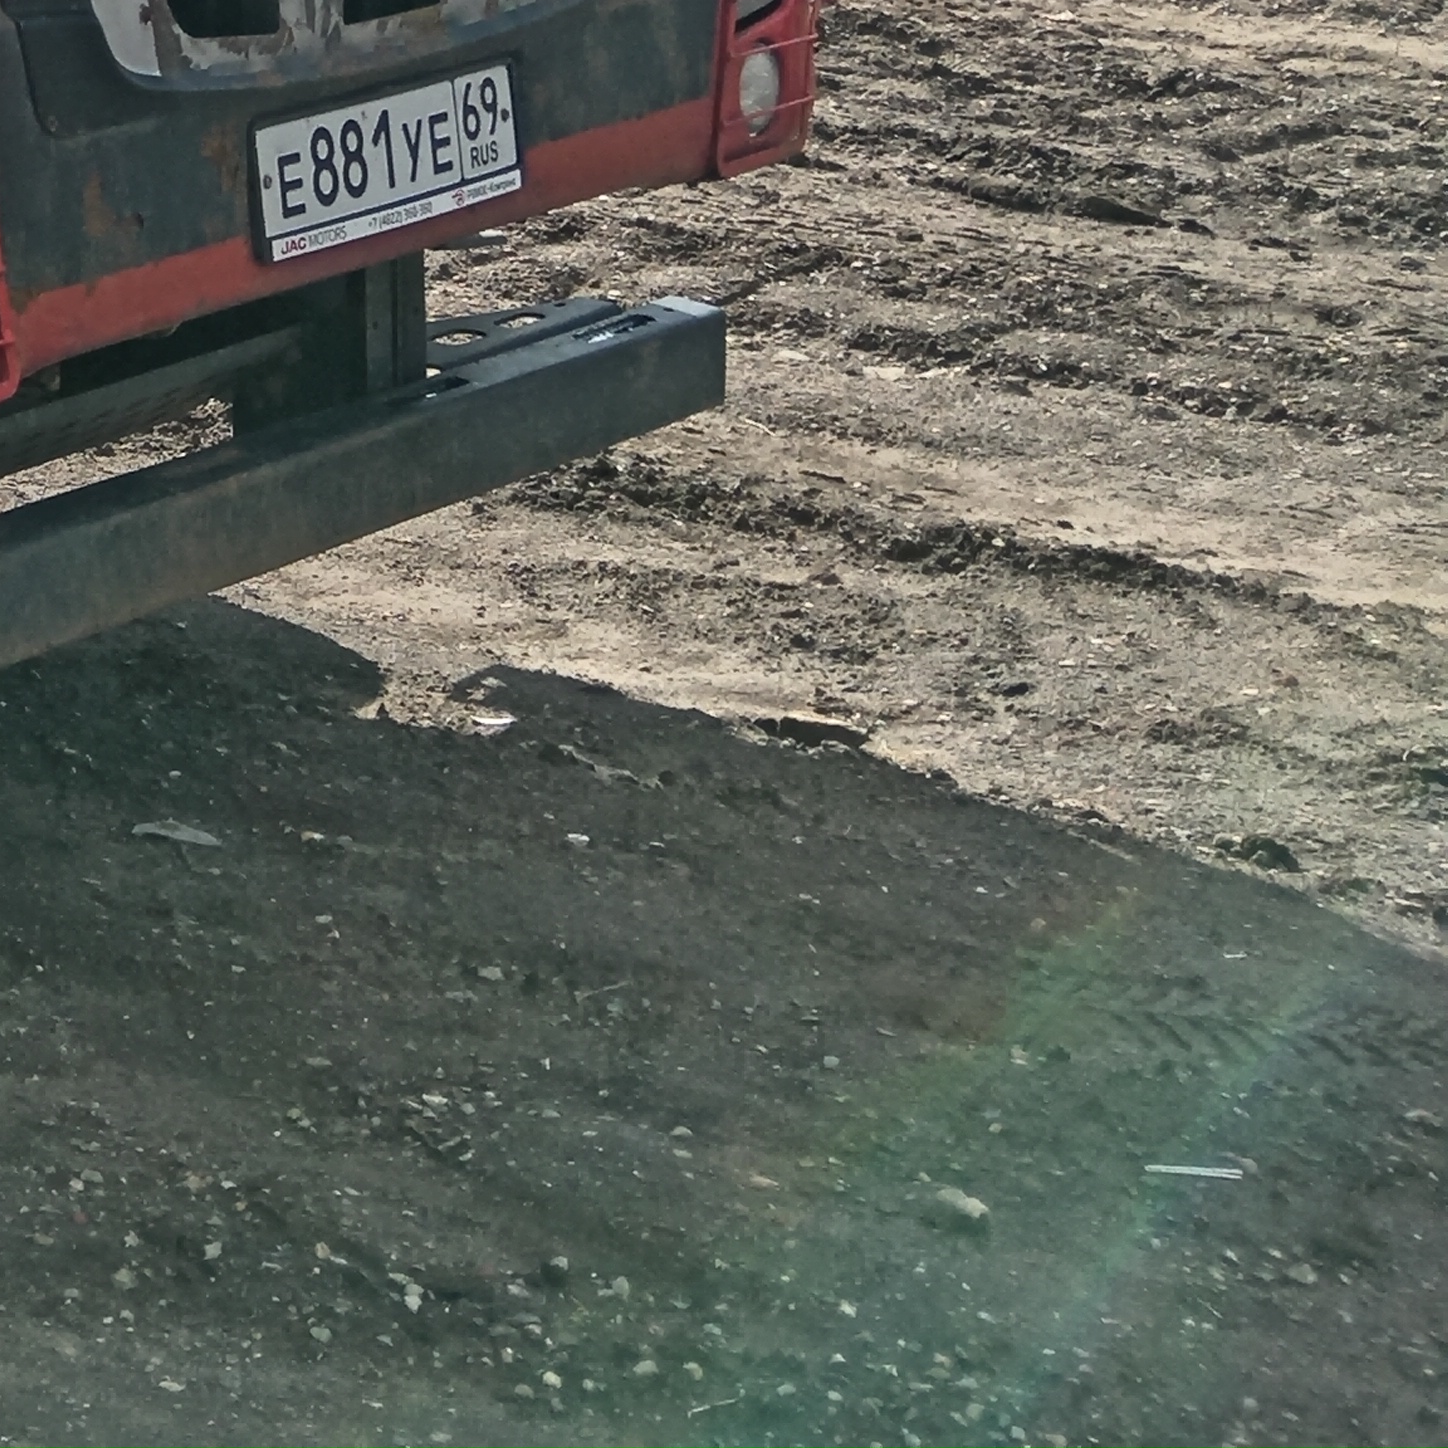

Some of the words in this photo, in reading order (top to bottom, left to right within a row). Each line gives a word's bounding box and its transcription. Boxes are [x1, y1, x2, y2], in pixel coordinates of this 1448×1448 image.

[461, 76, 498, 142] 69
[470, 140, 499, 169] RUS
[281, 237, 307, 255] JAC
[307, 225, 348, 247] MOTORS
